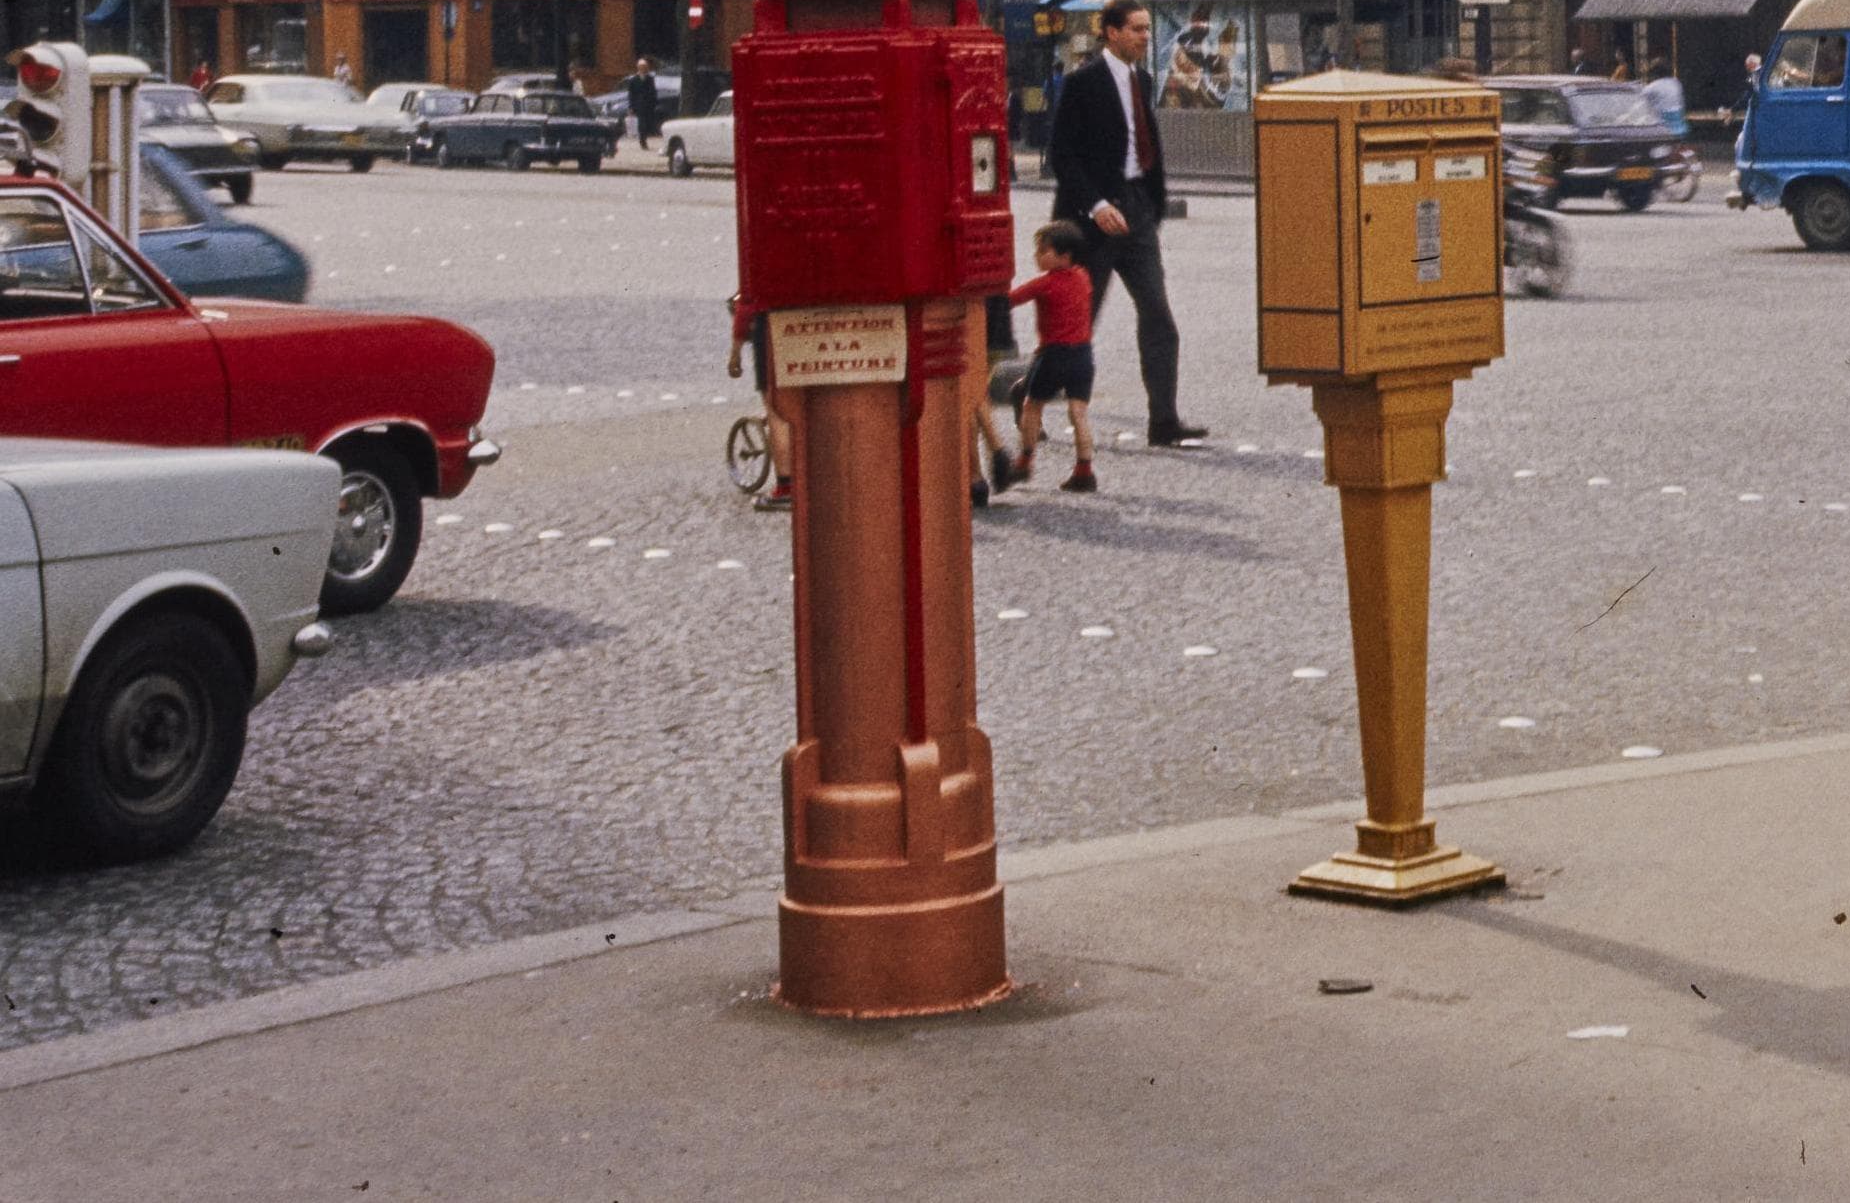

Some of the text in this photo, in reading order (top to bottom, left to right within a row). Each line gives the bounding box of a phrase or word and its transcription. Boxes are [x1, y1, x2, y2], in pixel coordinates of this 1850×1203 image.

[1387, 97, 1465, 117] POSTES
[783, 318, 895, 337] ATTENTION
[834, 340, 861, 351] LA
[786, 357, 897, 374] PEINTURE
